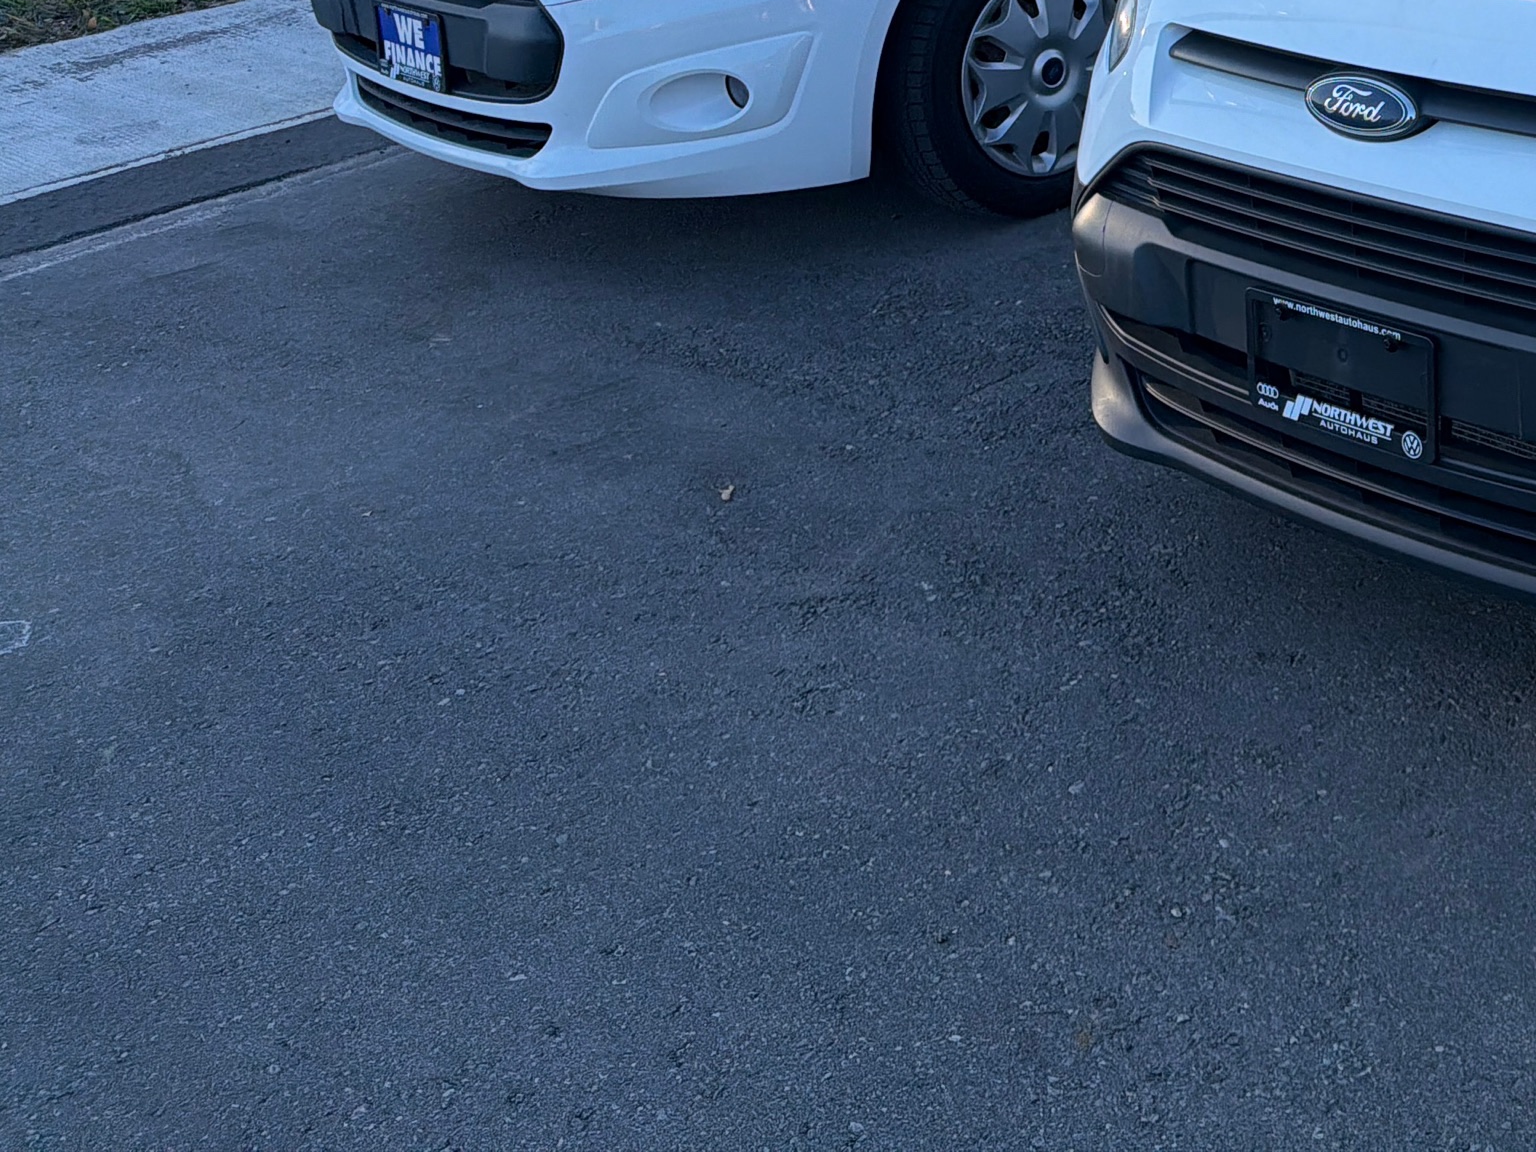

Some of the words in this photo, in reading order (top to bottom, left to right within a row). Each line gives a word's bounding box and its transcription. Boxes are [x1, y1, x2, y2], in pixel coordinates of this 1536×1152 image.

[393, 12, 425, 50] WE
[383, 39, 442, 77] FINANCE
[1324, 84, 1385, 123] Ford
[1258, 398, 1279, 412] Audi
[1312, 400, 1395, 437] NORTHWEST
[1320, 419, 1378, 445] AUTOHAUS
